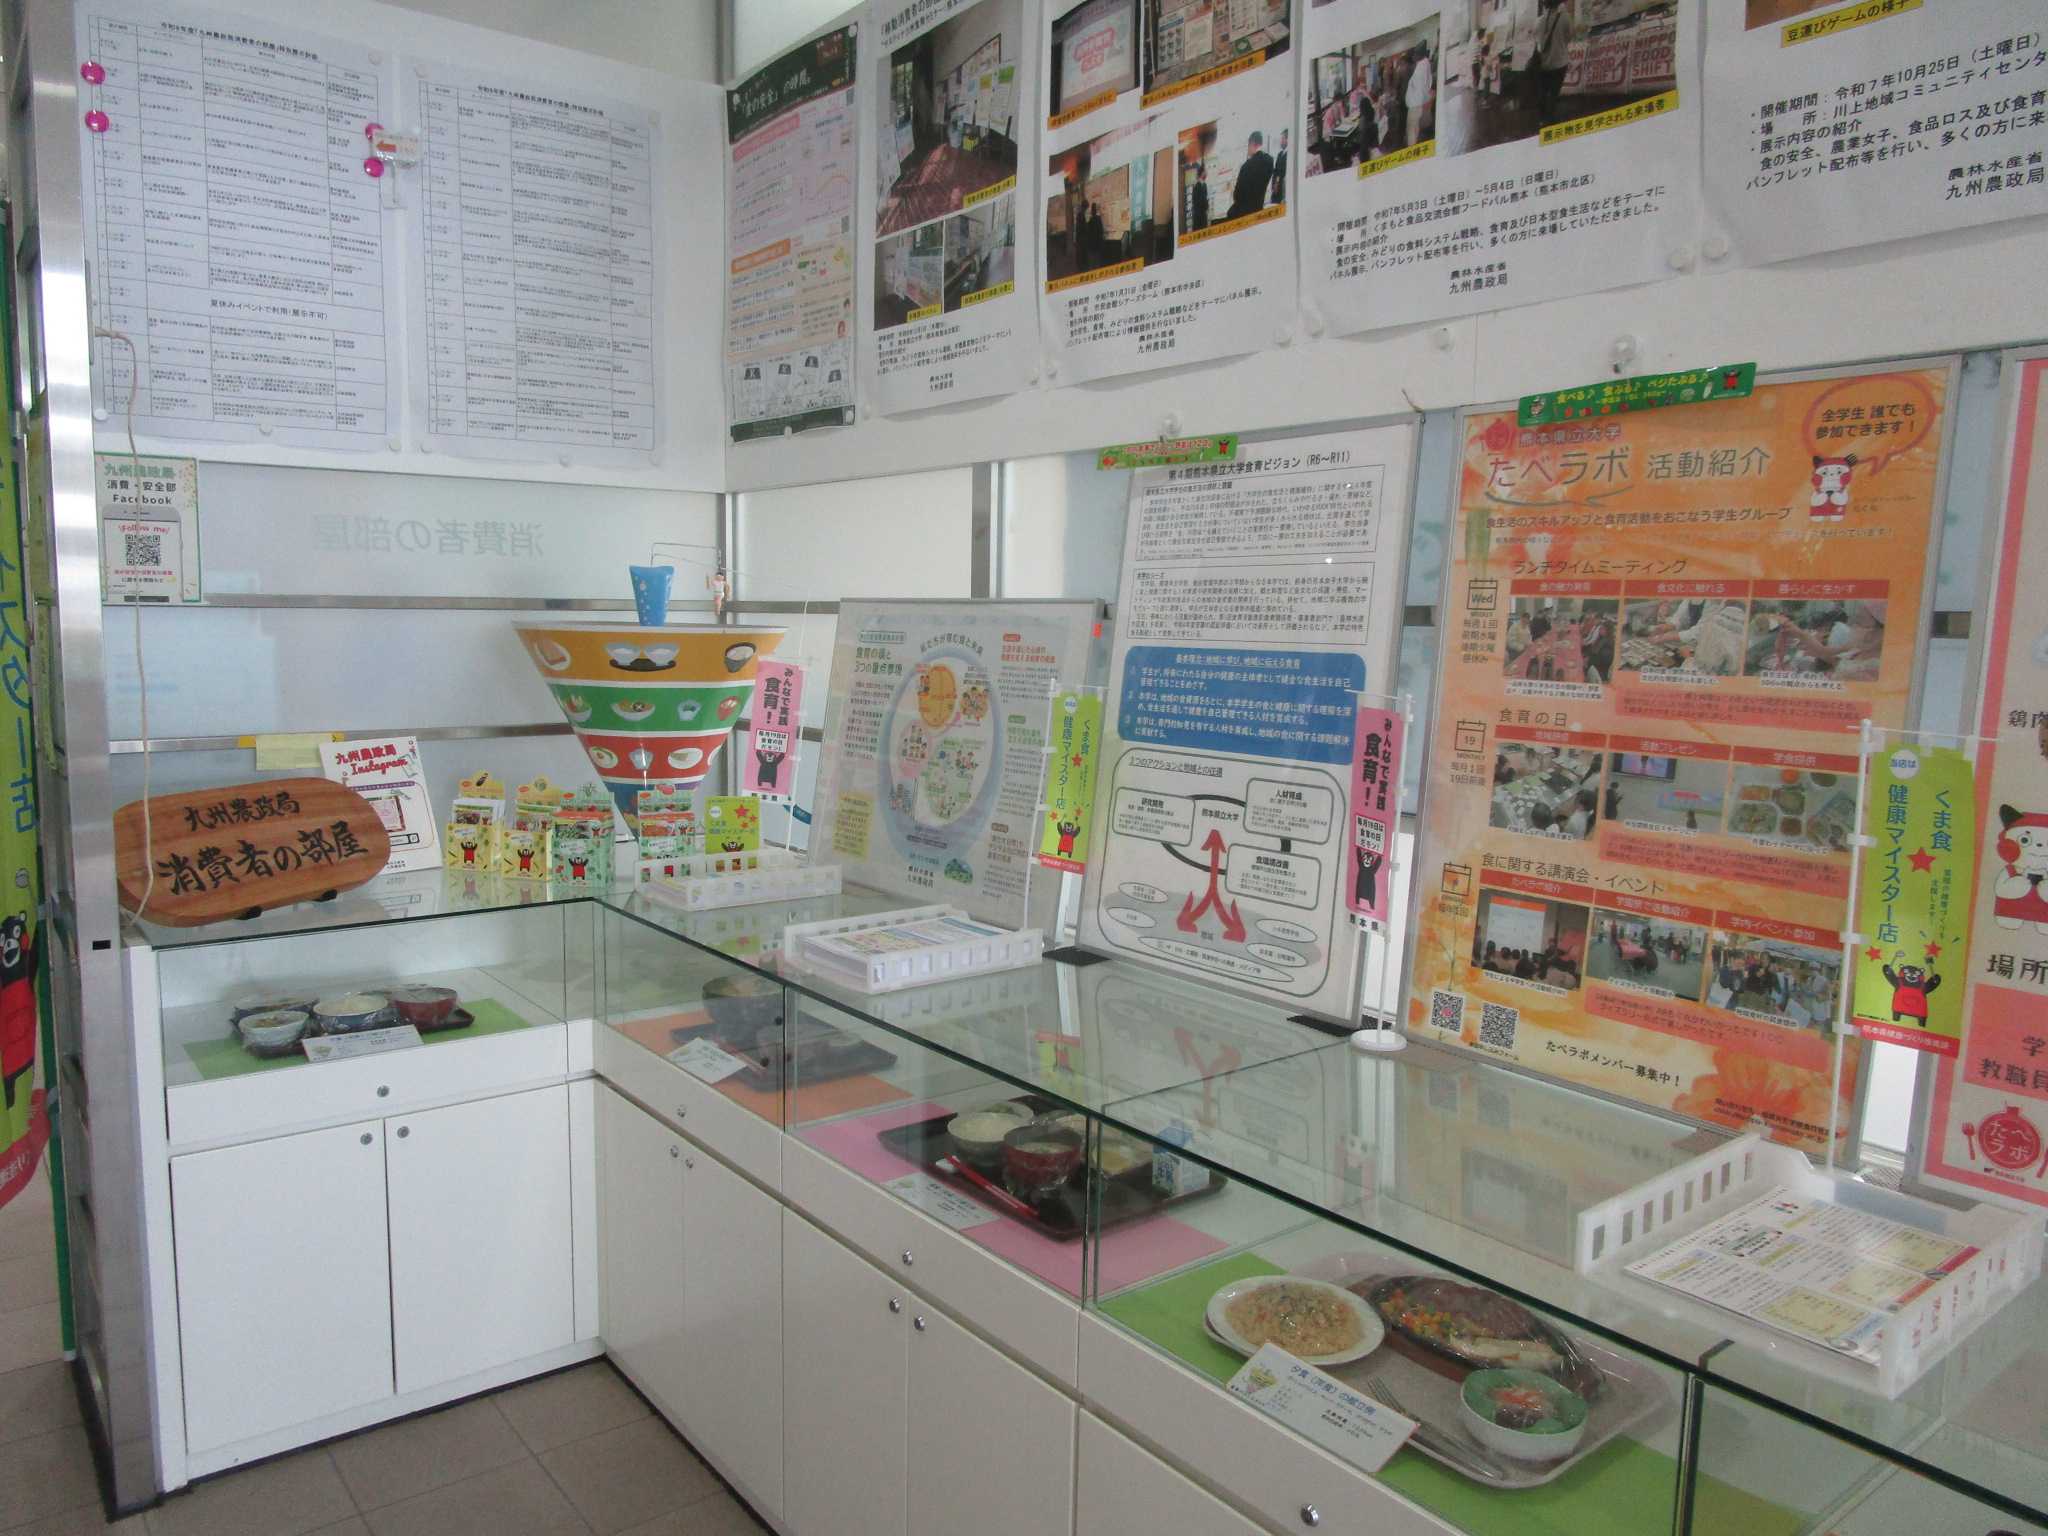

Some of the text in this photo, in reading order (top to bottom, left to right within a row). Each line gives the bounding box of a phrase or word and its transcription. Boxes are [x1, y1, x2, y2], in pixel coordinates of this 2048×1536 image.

[1543, 98, 1666, 142] 展示物を見学される来場者
[1948, 152, 2043, 180] 農林水産省
[1946, 167, 2045, 200] 九州農政局
[1451, 262, 1507, 280] 農林水産省
[1450, 274, 1508, 295] 九州農政局
[1821, 403, 1916, 422] 全学生 誰でも
[1519, 425, 1622, 446] 熊本県立大学
[1815, 420, 1915, 439] 参加できます！
[1488, 446, 1770, 488] たべラボ 活動紹介
[107, 480, 177, 492] 消費・安全部
[1486, 506, 1792, 528] 食生活のスキルアップと食育活動をおこなう学生グループ
[1513, 560, 1687, 575] ランチタイムミーティング
[1471, 594, 1493, 604] Wed
[1657, 583, 1724, 594] 食文化に触れる
[1779, 584, 1856, 595] 暮らしに生かす
[1461, 631, 1497, 641] 前期水曜
[1460, 643, 1495, 653] 後期火曜
[1461, 654, 1489, 664] 昼休み
[763, 677, 781, 725] 食育！
[778, 668, 794, 726] みんなで実践
[1500, 708, 1568, 727] 食育の日
[1081, 719, 1090, 756] くま食
[1464, 735, 1476, 745] 19
[1640, 740, 1697, 755] 活動プレゼン
[335, 744, 397, 765] 九州農政局
[1055, 716, 1073, 810] 健康マイスター店
[1376, 718, 1393, 812] みんなで実践
[1773, 753, 1816, 767] 学食提供
[1889, 758, 1918, 768] 当店は
[351, 759, 408, 775] Instagram
[1362, 732, 1382, 807] 食育！
[1450, 774, 1487, 787] 19日前後
[1275, 789, 1303, 801] 人材育成
[183, 791, 300, 832] 九州農政局
[1201, 808, 1239, 821] 熊本県立大学
[1931, 790, 1952, 852] くま食
[1357, 817, 1384, 832] 毎月19日は
[1360, 828, 1381, 842] 食育の日
[157, 820, 369, 895] 消費者の部屋
[1255, 856, 1289, 869] 食環境改善
[1877, 784, 1910, 944] 健康マイスター店
[1482, 853, 1664, 896] 食に関する講演会・イベント
[1511, 877, 1562, 893] たべラボ紹介
[1616, 896, 1691, 918] 学園祭で活動紹介
[1349, 913, 1379, 932] 熊本県
[1731, 916, 1816, 942] 学内イベント参加
[1200, 931, 1214, 941] 地域
[1986, 953, 2048, 985] 場所
[2023, 1035, 2047, 1057] 学
[1546, 1040, 1681, 1087] たべラボメンバー募集中！
[1989, 1120, 2033, 1142] たべ
[1990, 1137, 2029, 1160] ラボ
[1290, 1364, 1377, 1416] 夕食（洋食）の献立例
